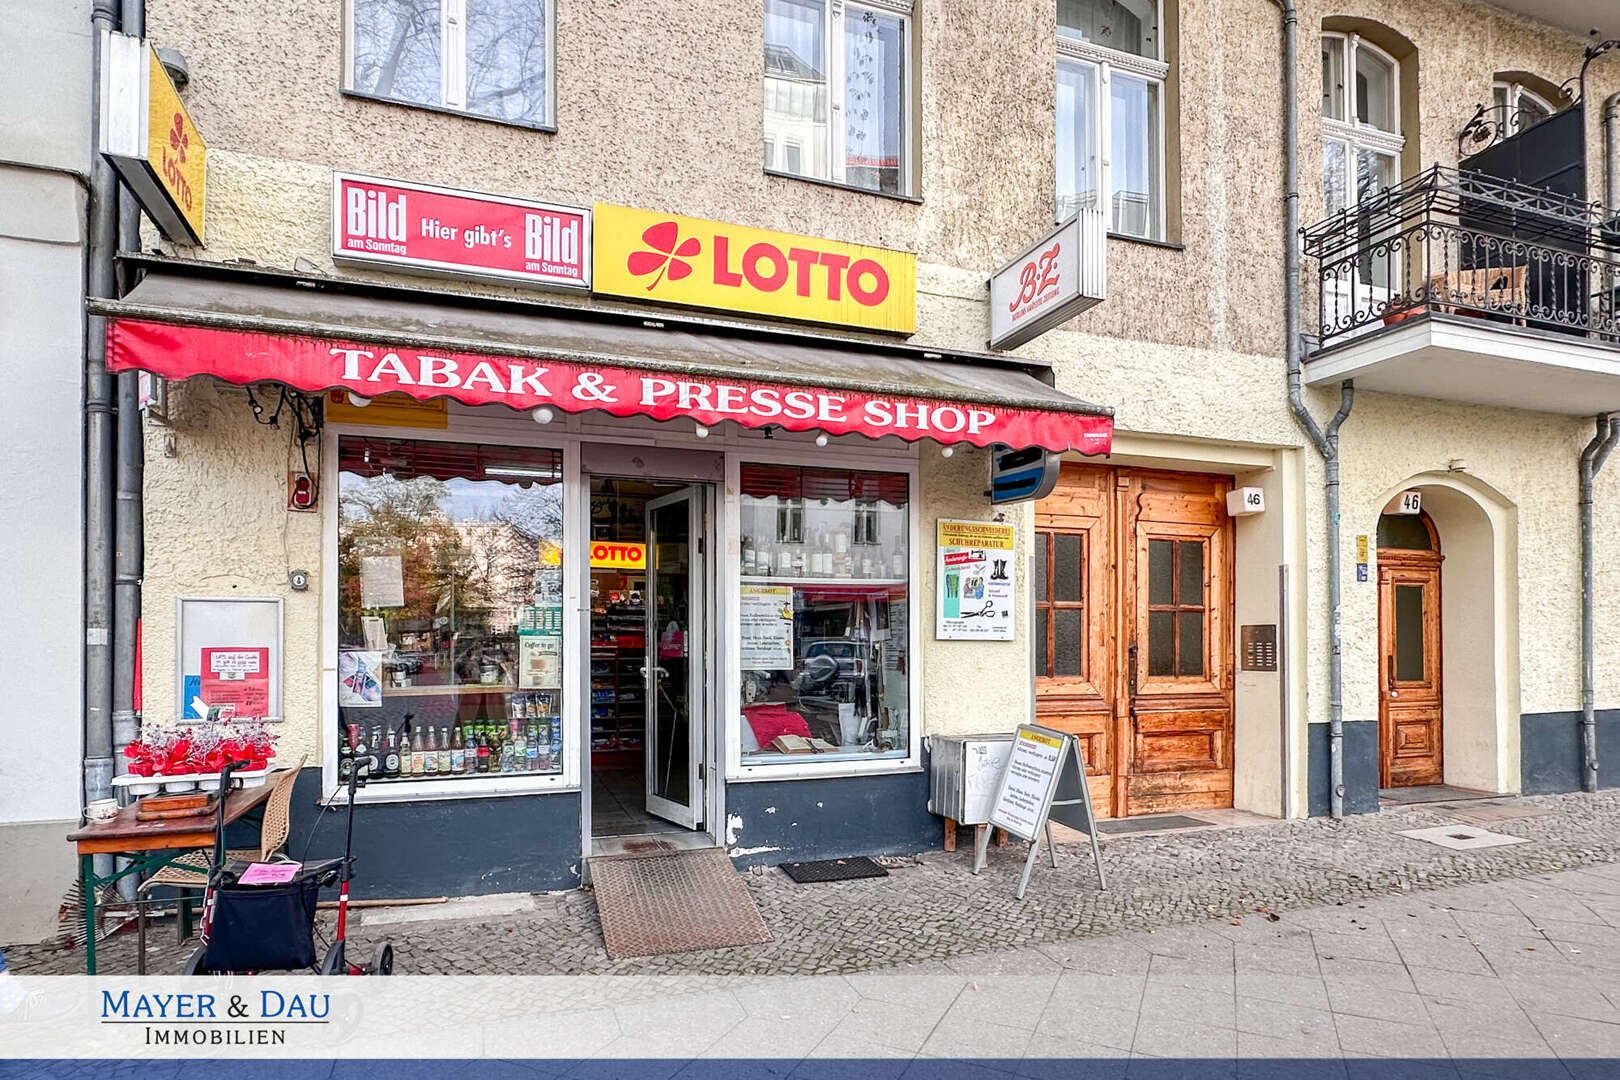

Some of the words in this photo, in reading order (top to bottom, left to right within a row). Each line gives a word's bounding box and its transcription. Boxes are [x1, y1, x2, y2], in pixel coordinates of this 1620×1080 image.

[162, 145, 193, 213] LOTTO
[347, 186, 407, 243] Bild
[347, 238, 365, 249] am
[365, 239, 407, 256] Sonntag
[421, 217, 459, 241] Hier
[464, 226, 513, 249] gibt's
[525, 213, 578, 265] Bild
[525, 261, 540, 271] am
[541, 262, 578, 278] Sonntag
[713, 235, 890, 307] LOTTO
[329, 348, 554, 397] TABAK
[571, 373, 619, 402] &
[639, 377, 848, 423] PRESSE
[863, 400, 997, 435] SHOP
[1247, 493, 1261, 505] 46
[1404, 493, 1419, 510] 46
[590, 545, 642, 562] OTTO
